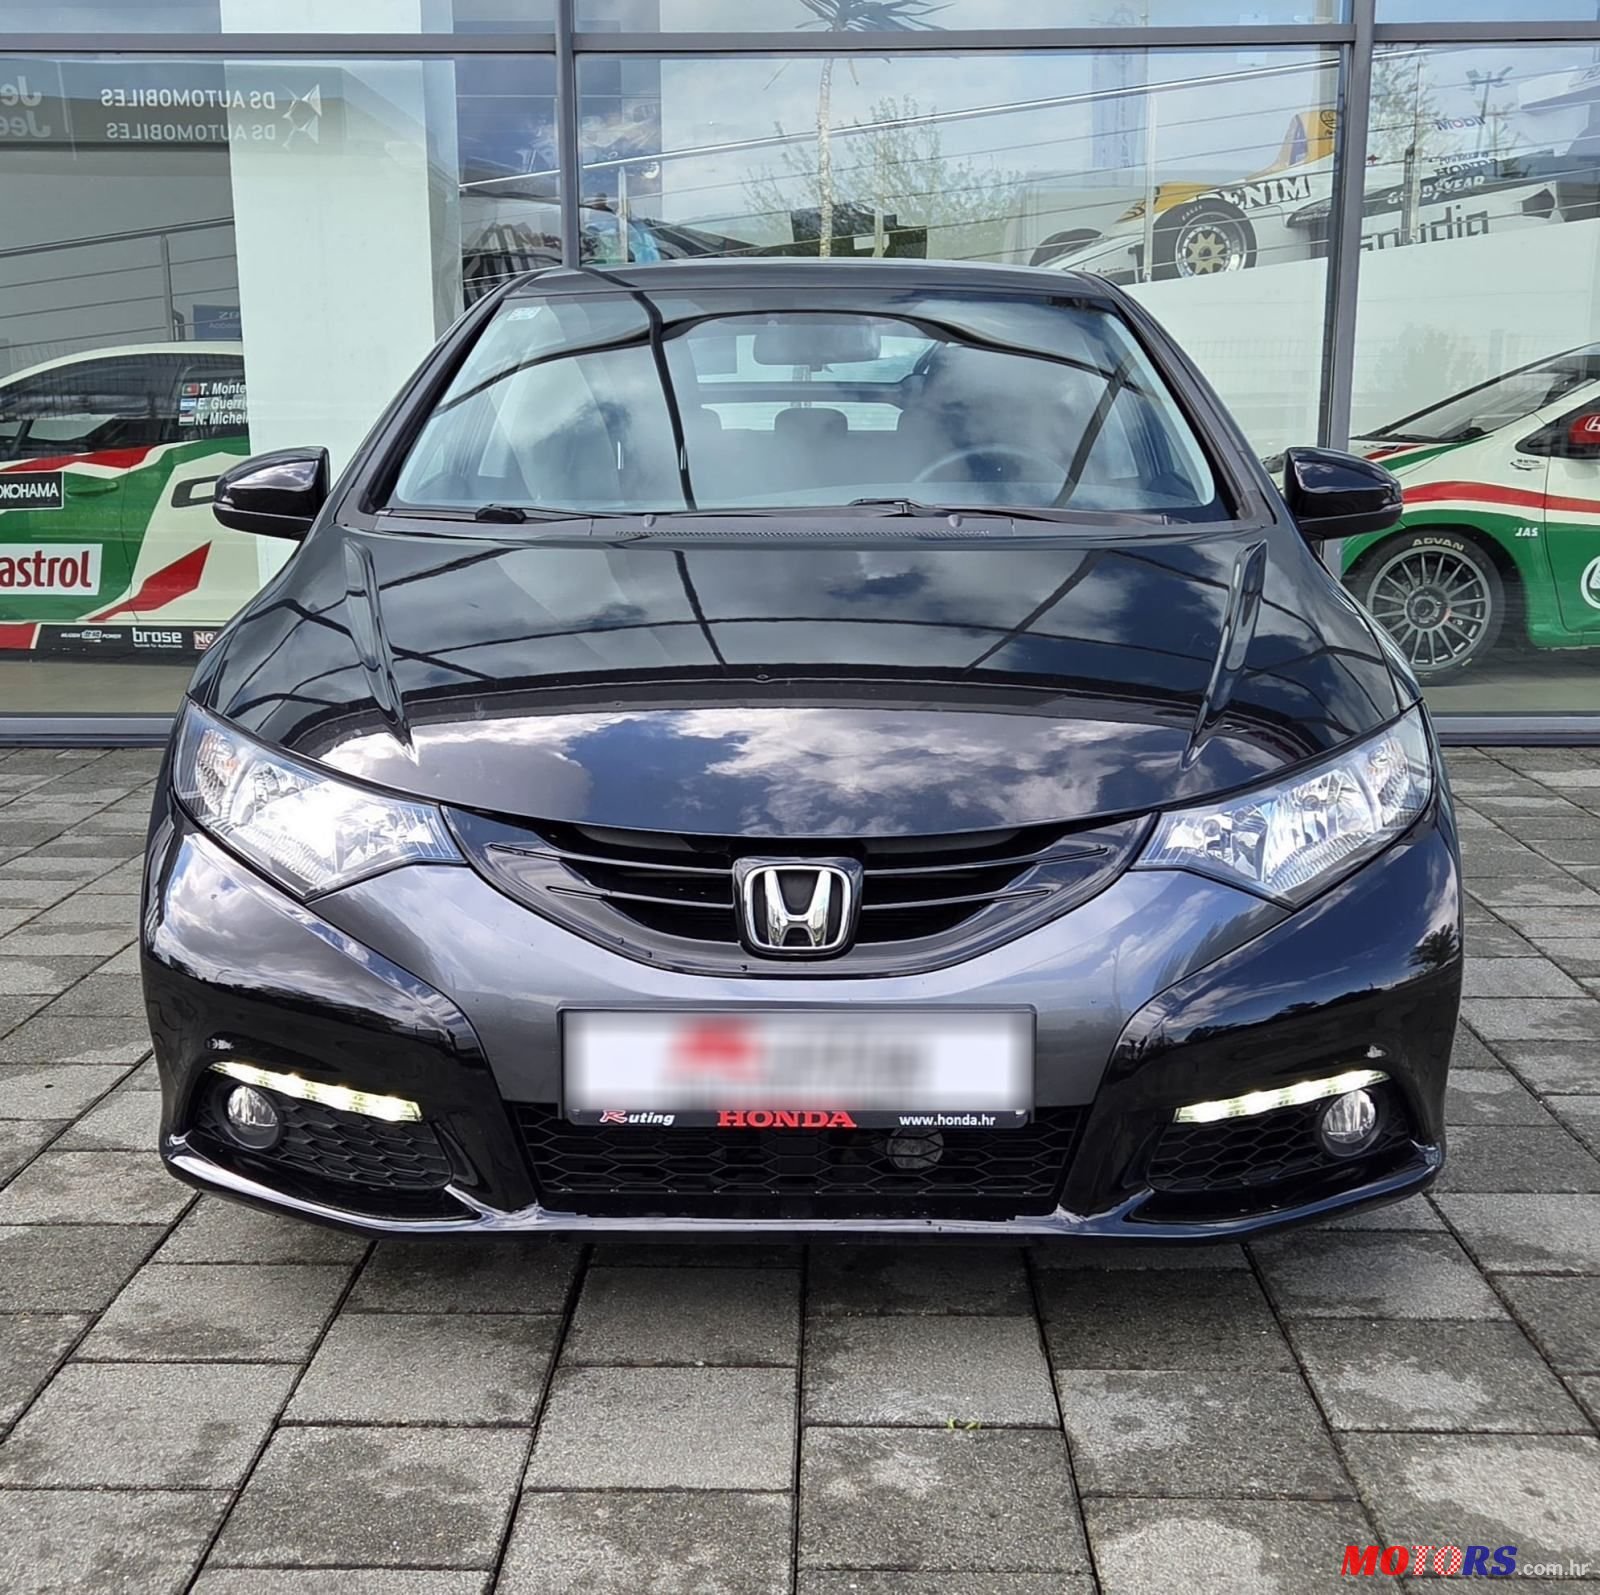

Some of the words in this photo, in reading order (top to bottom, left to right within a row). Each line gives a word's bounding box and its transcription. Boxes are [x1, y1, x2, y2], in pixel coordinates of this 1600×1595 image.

[200, 383, 210, 395] T.
[211, 382, 246, 395] Monte
[197, 397, 208, 410] E.
[210, 397, 247, 410] Guerr
[195, 412, 207, 426] N.
[1515, 527, 1538, 537] JAS
[1412, 537, 1464, 550] ADVAN
[132, 626, 183, 643] brose
[600, 1109, 675, 1127] Ruting
[717, 1110, 857, 1128] HONDA
[898, 1111, 996, 1128] www.honda.hr
